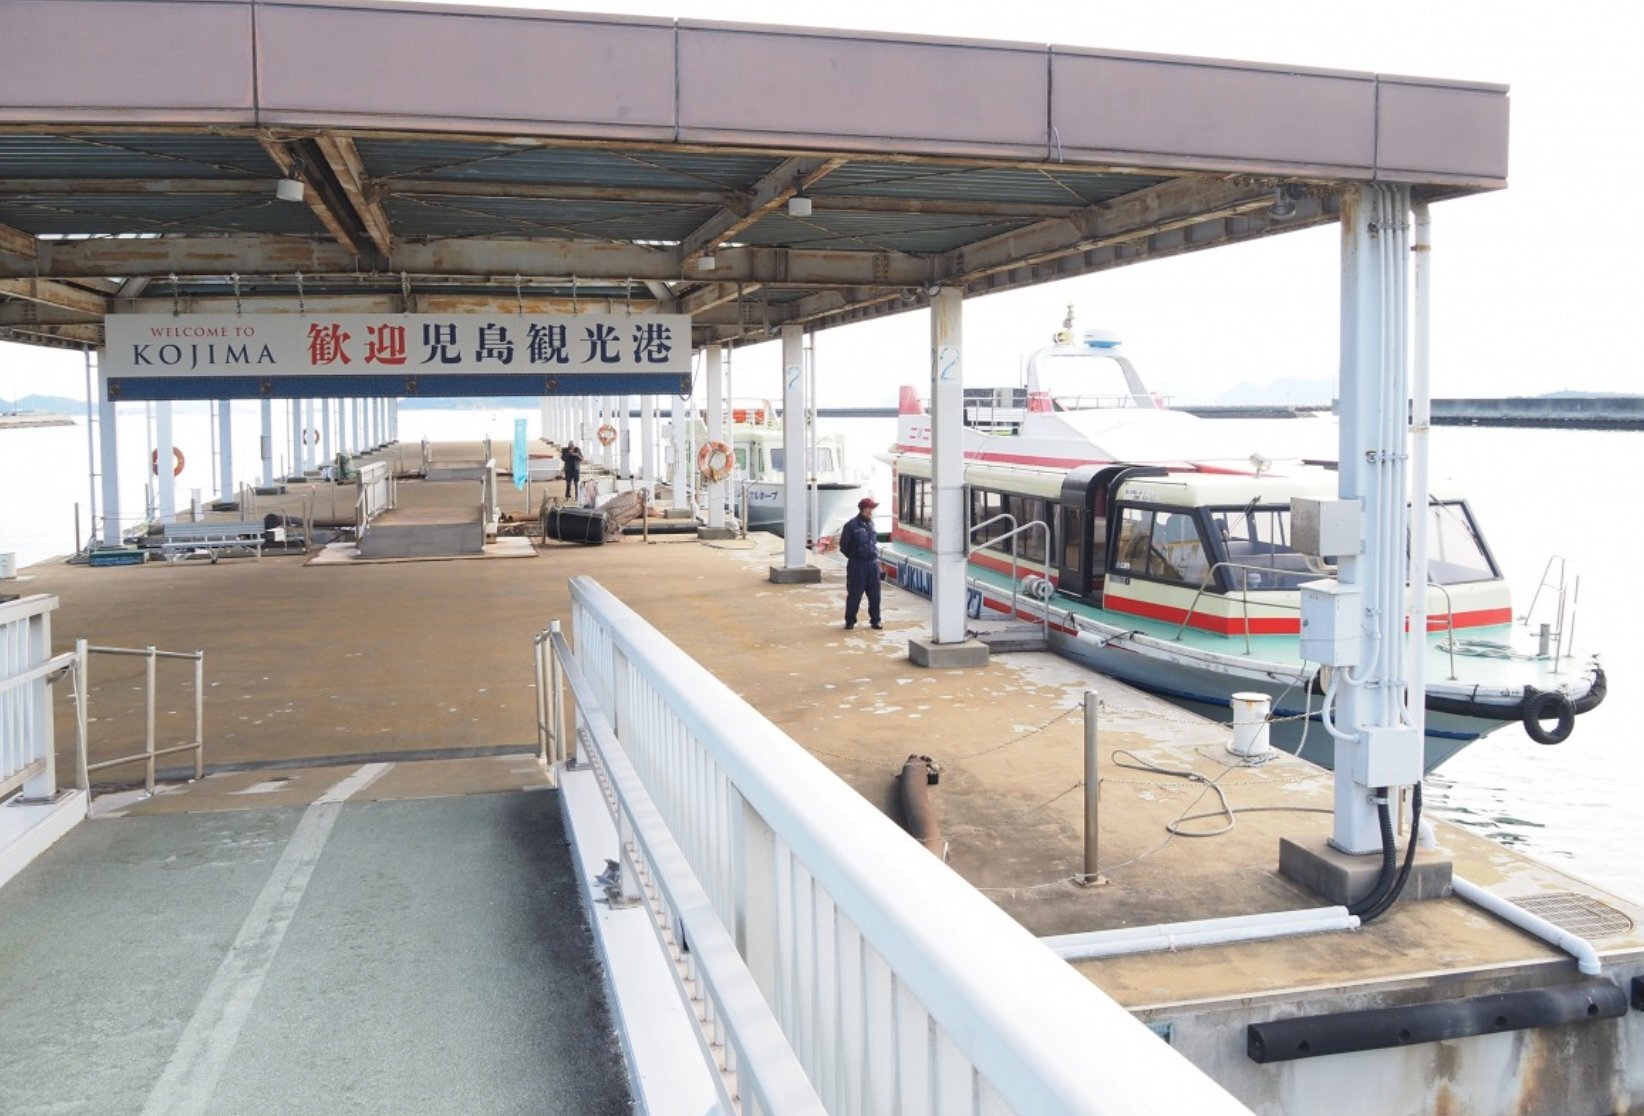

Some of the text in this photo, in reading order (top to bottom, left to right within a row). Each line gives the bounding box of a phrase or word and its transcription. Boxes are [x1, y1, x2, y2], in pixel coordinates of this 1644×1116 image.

[151, 326, 255, 337] WELCOME TO
[132, 343, 277, 370] KOJIMA
